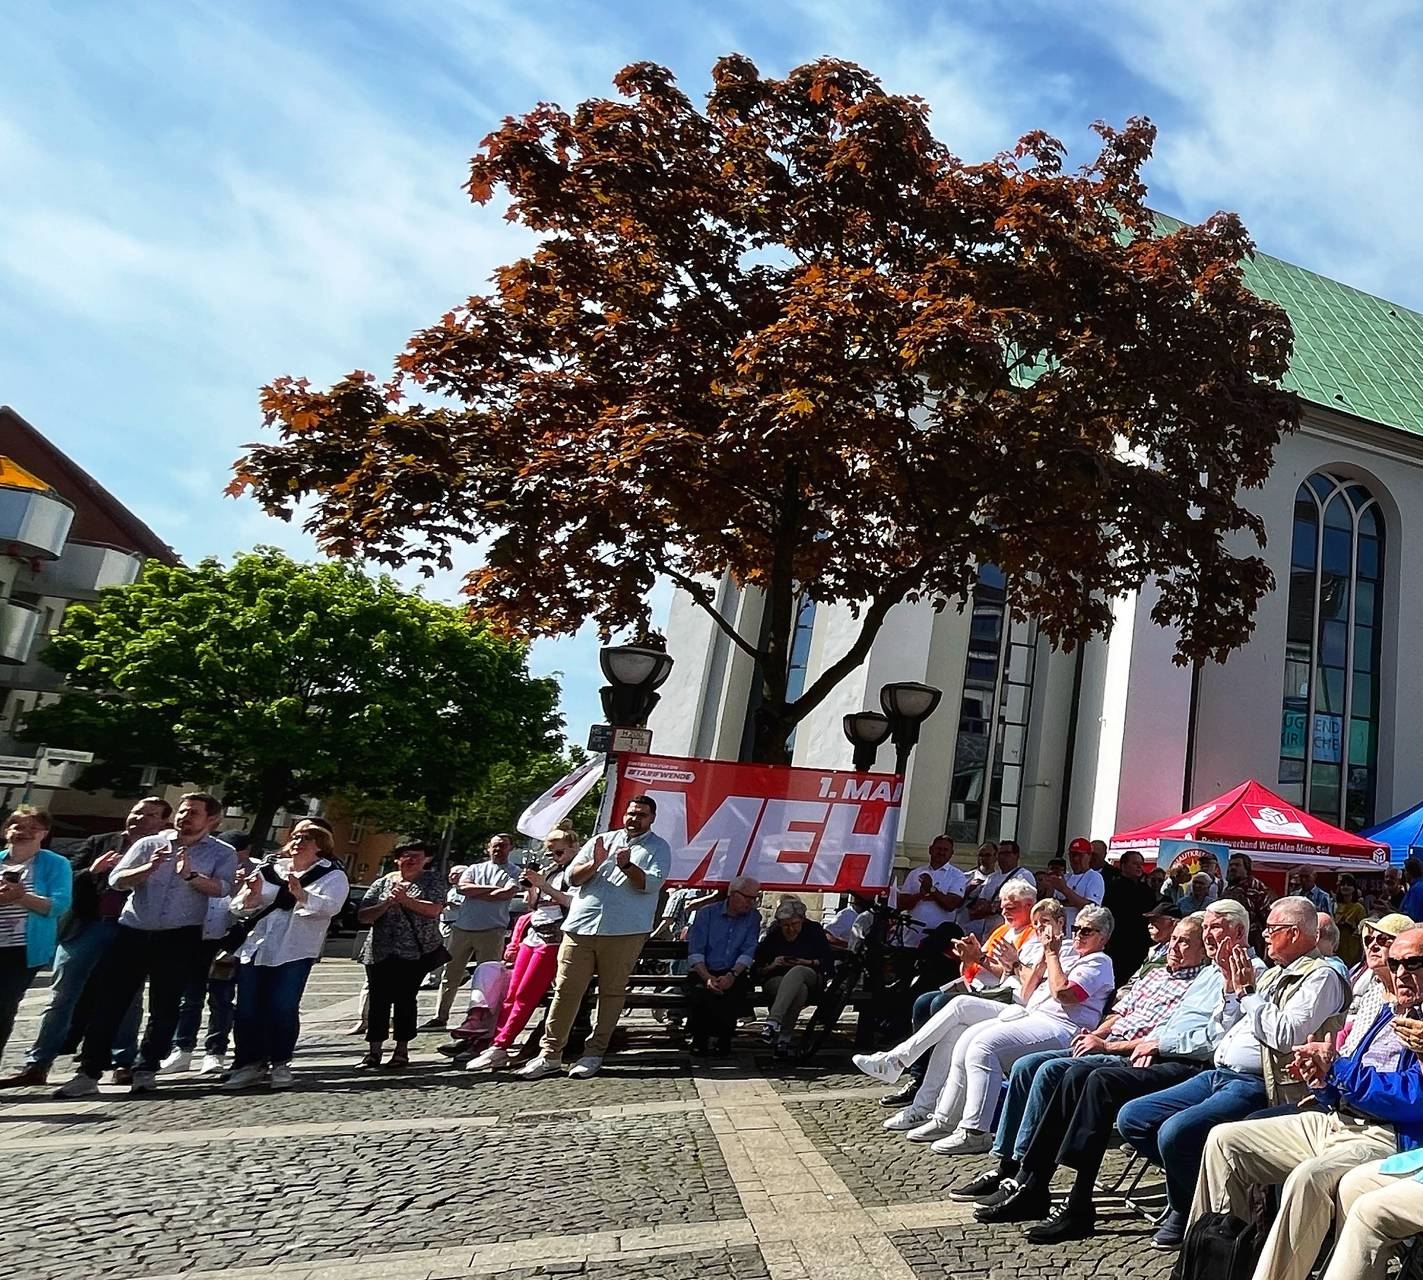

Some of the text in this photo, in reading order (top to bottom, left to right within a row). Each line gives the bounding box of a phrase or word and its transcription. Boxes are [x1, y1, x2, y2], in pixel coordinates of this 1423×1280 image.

[627, 768, 692, 781] #TARIFWENDE
[818, 777, 903, 802] 1. MAI
